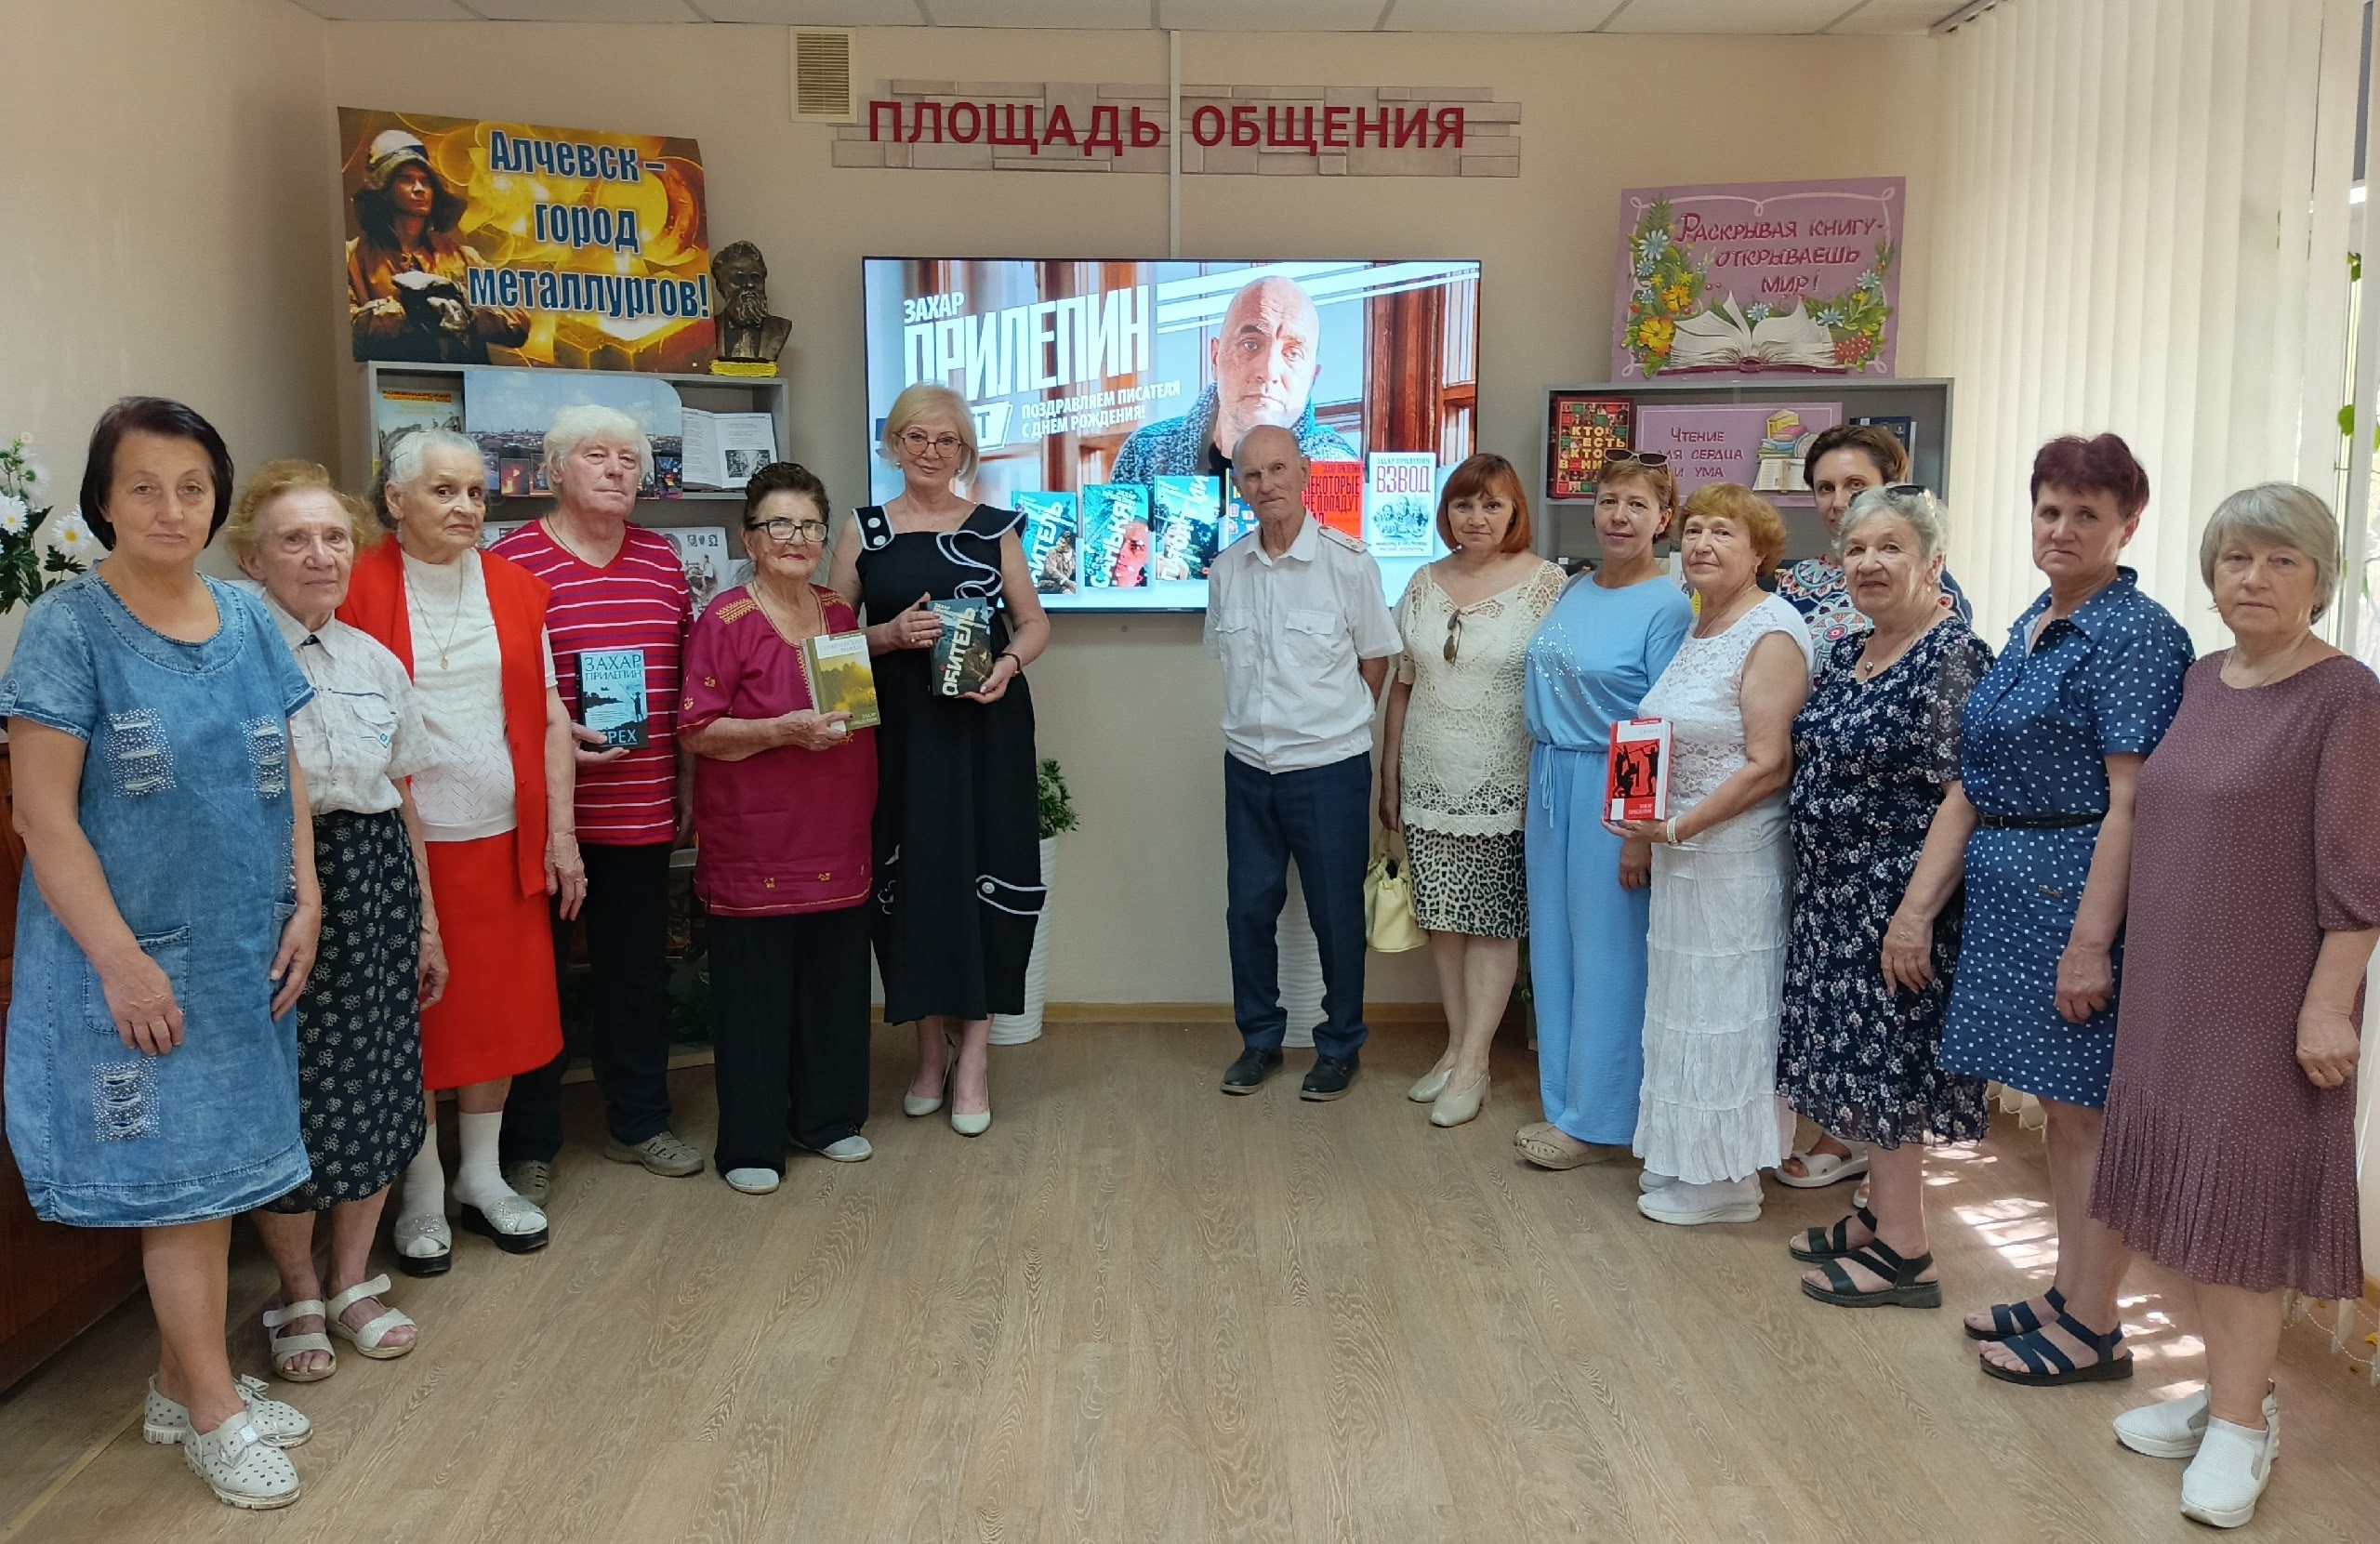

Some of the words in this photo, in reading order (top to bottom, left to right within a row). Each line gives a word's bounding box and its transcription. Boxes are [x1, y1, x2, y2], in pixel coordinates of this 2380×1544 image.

[868, 99, 1161, 157] ПЛОЩАДЬ
[1192, 104, 1466, 156] ОБЩЕНИЯ
[534, 203, 641, 255] город
[1715, 245, 1860, 268] ОТКРЫВАЕШЬ
[466, 266, 713, 320] металлургов!
[1761, 270, 1821, 294] МИР!
[904, 291, 965, 323] ЗАХАР
[903, 284, 1150, 402] ПРИЛЕПИН
[1021, 389, 1116, 419] ПОЗДРАВЛЯЕМ
[1117, 379, 1181, 404] ПИСАТЕЛЯ
[1021, 423, 1031, 439] С
[1031, 417, 1068, 440] ДНЕМ
[1070, 404, 1146, 431] РОЖДЕНИЯ!
[1571, 426, 1605, 437] КТО
[1570, 447, 1604, 459] КТО
[1582, 437, 1626, 448] ЕСТЬ
[1559, 458, 1569, 469] В
[1580, 459, 1606, 469] МИ
[1659, 449, 1684, 460] ЛЯ
[1690, 448, 1744, 461] СЕРДЦА
[1375, 465, 1431, 494] ВЗВОД
[1674, 467, 1685, 478] И
[1695, 467, 1725, 478] УМА
[1316, 495, 1361, 516] ПОПАДУТ
[585, 653, 641, 671] ЗАХАР
[941, 607, 987, 696] ОБИТЕЛЬ
[586, 669, 642, 681] ПРИЛЕПИН
[602, 729, 638, 744] РЕХ
